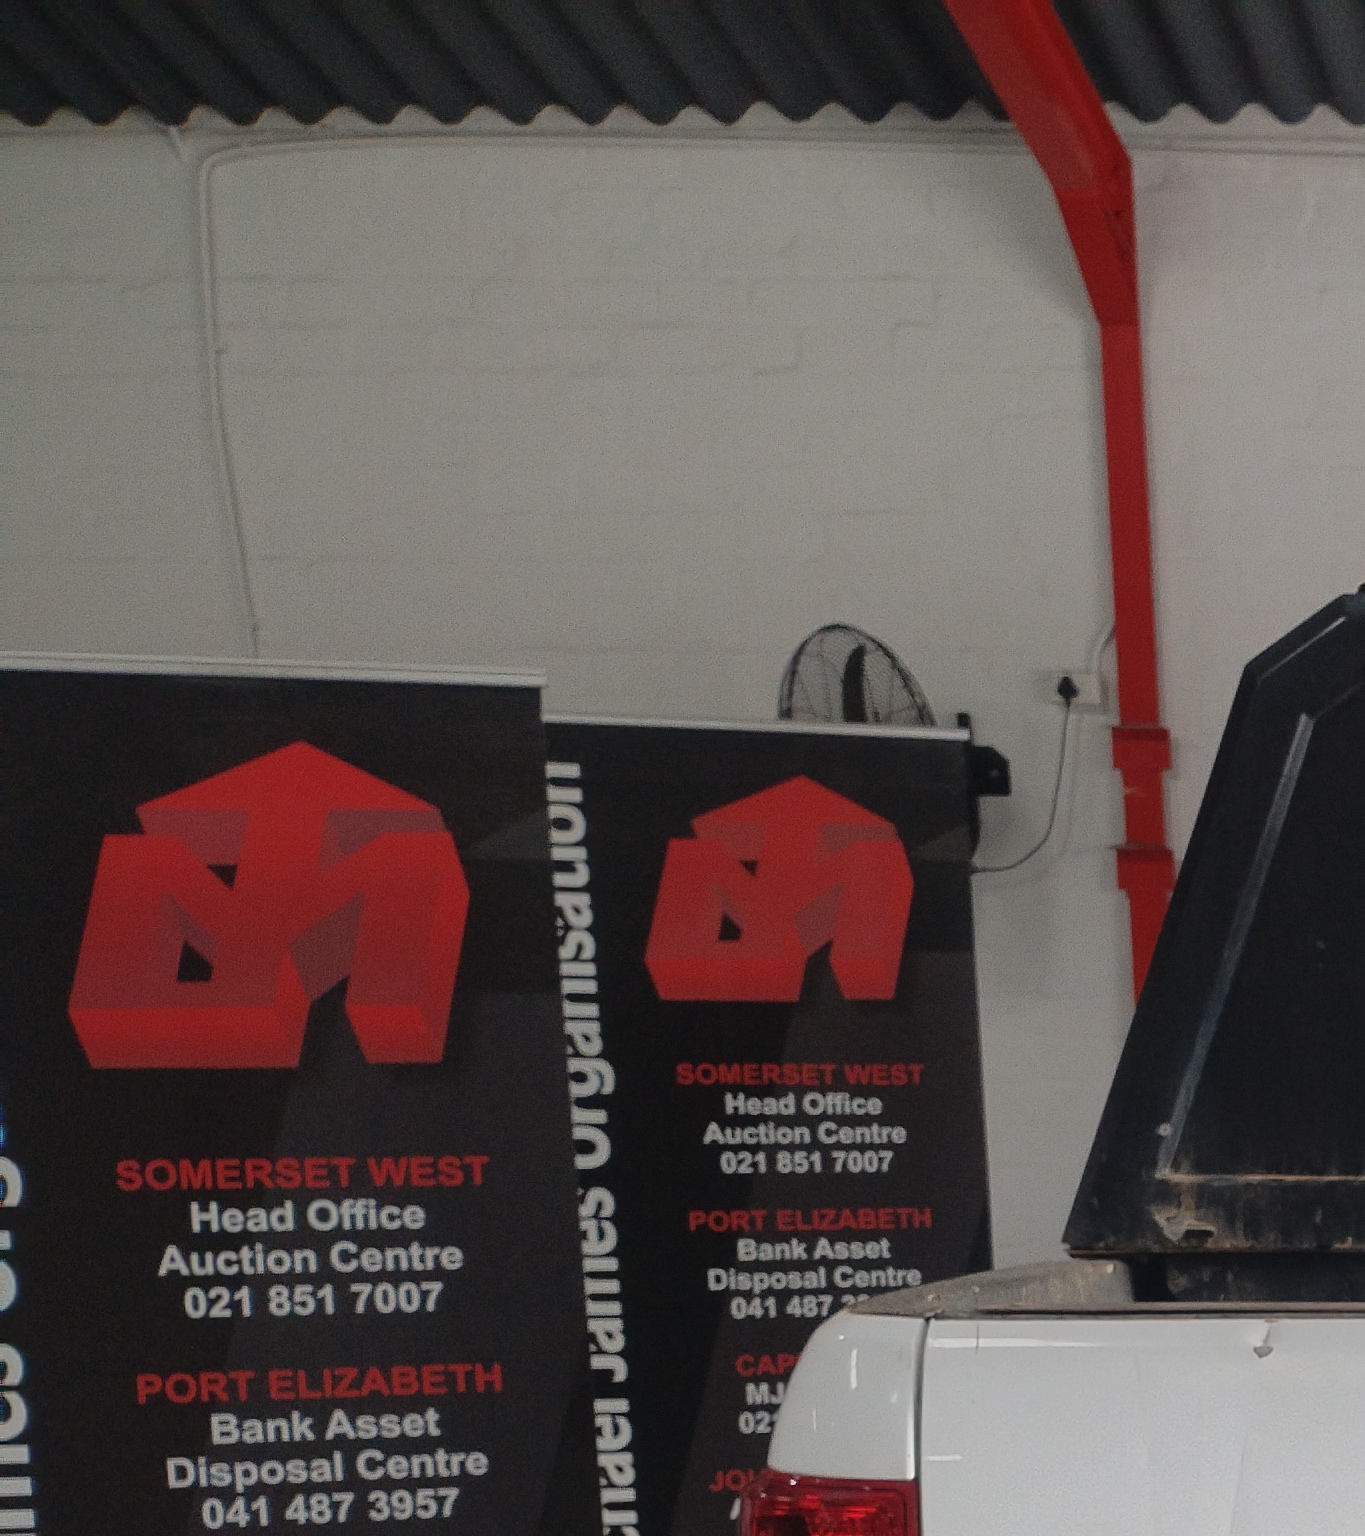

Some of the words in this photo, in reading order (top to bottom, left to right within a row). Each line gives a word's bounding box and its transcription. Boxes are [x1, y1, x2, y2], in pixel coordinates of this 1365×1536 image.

[677, 1063, 835, 1085] SOMERSET
[845, 1064, 922, 1085] WEST
[725, 1092, 796, 1115] Head
[803, 1092, 882, 1115] Office
[703, 1122, 811, 1144] Auction
[818, 1122, 906, 1144] Centre
[116, 1157, 355, 1191] SOMERSET
[368, 1156, 488, 1186] WEST
[720, 1151, 766, 1174] 021
[777, 1151, 821, 1173] 851
[832, 1150, 893, 1173] 7007
[191, 1200, 294, 1233] Head
[307, 1198, 425, 1231] Office
[689, 1210, 766, 1231] PORT
[777, 1208, 931, 1230] ELIZABETH
[158, 1243, 317, 1276] Auction
[330, 1241, 463, 1272] Centre
[737, 1238, 808, 1261] Bank
[814, 1237, 891, 1259] Asset
[708, 1266, 827, 1294] Disposal
[833, 1265, 922, 1288] Centre
[185, 1286, 251, 1318] 021
[269, 1284, 334, 1316] 851
[350, 1282, 443, 1313] 7007
[731, 1297, 776, 1319] 041
[786, 1294, 833, 1317] 487
[735, 1354, 802, 1377] CAP
[137, 1371, 254, 1404] PORT
[268, 1363, 502, 1400] ELIZABETH
[211, 1411, 315, 1444] Bank
[325, 1408, 441, 1440] Asset
[167, 1451, 343, 1493] Disposal
[356, 1449, 488, 1480] Centre
[202, 1496, 268, 1529] 041
[285, 1492, 354, 1524] 487
[368, 1487, 459, 1521] 3957
